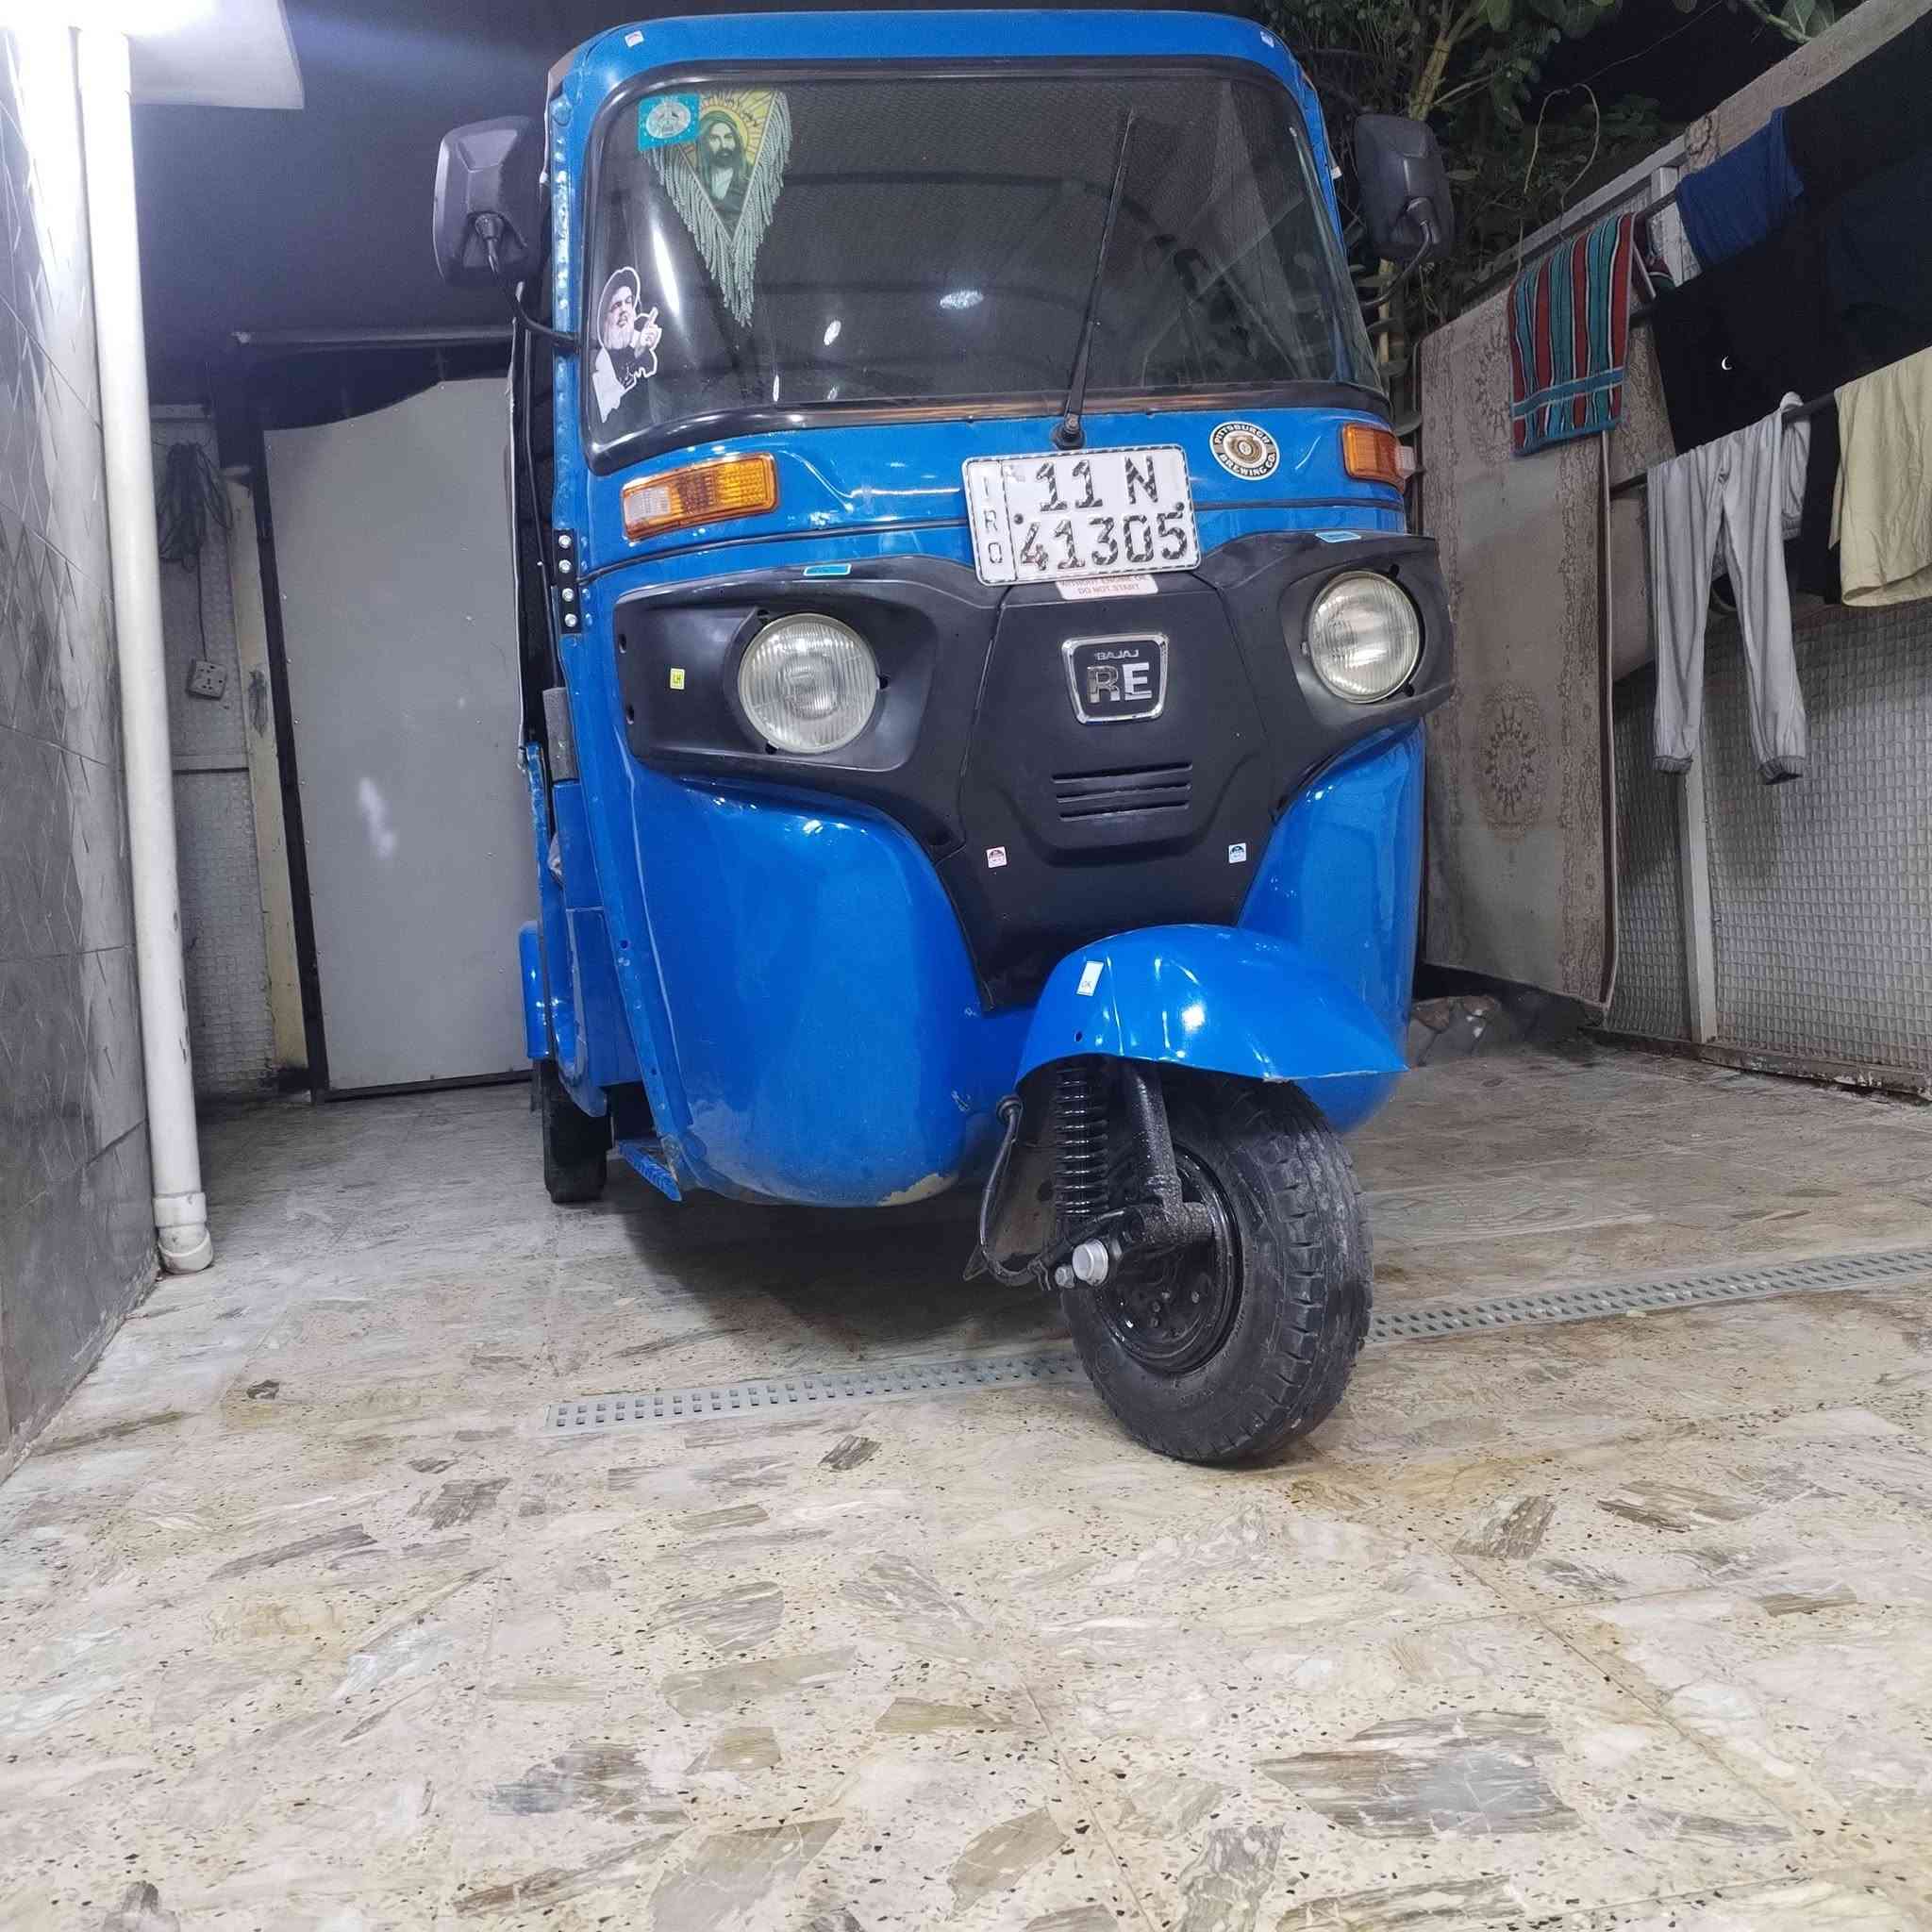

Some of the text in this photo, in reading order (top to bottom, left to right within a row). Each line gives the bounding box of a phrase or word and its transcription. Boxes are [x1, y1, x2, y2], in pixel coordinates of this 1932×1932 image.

[1036, 455, 1158, 512] 11 N
[1220, 454, 1267, 476] BREWING
[1020, 511, 1188, 571] 41305
[1096, 649, 1140, 661] BAJAJ
[1086, 661, 1152, 704] RE
